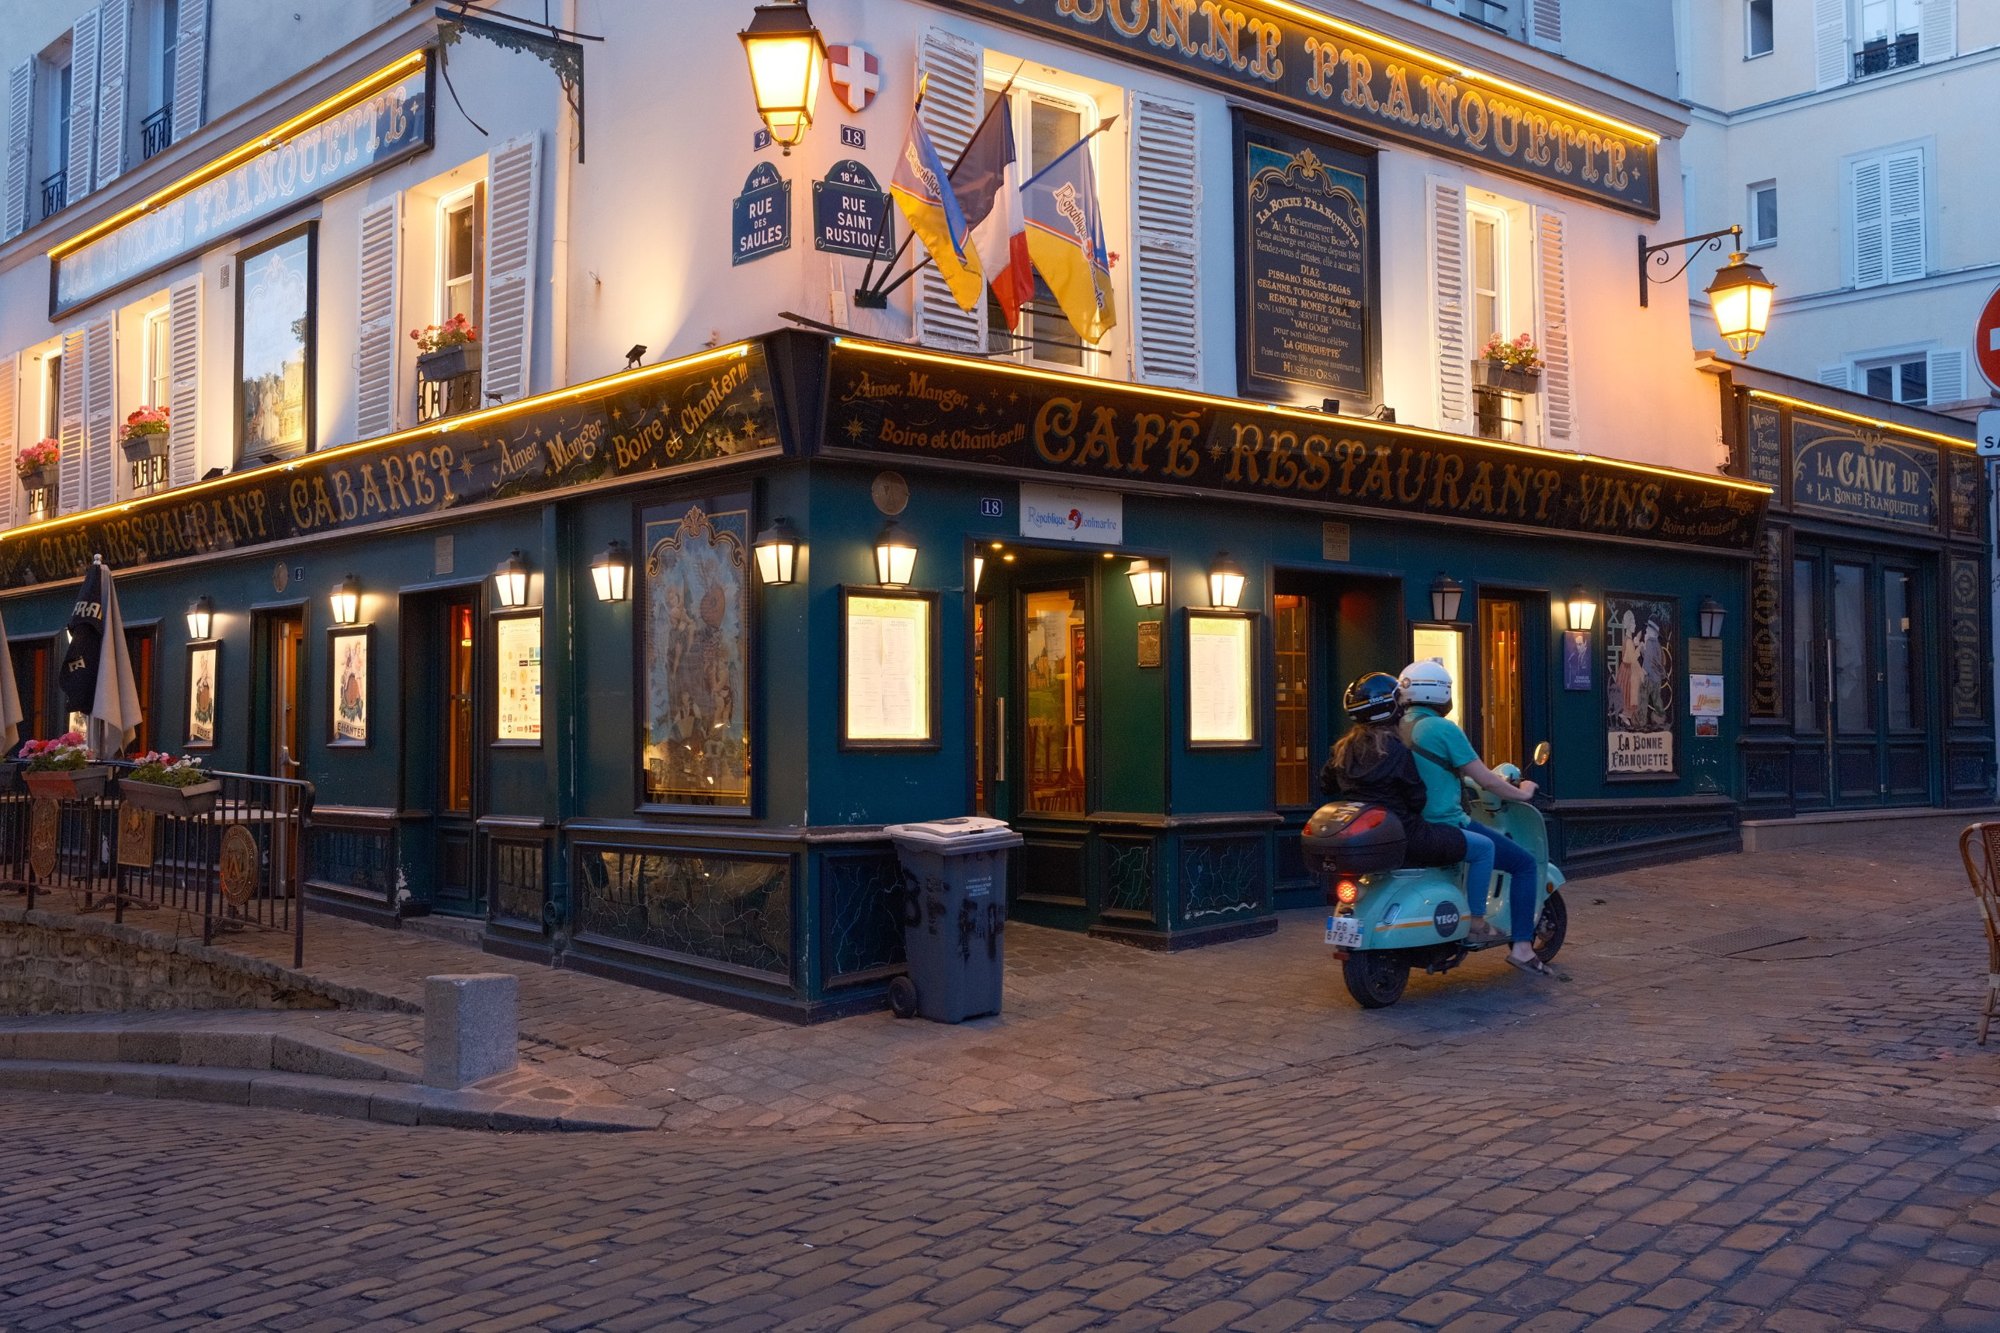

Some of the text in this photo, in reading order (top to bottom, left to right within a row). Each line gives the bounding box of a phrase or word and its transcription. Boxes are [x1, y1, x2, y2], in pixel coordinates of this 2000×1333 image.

[1305, 36, 1629, 191] FRANQUETTE
[759, 132, 766, 146] 2
[845, 130, 861, 146] 18
[102, 200, 186, 281] BONNE
[194, 86, 407, 238] FRANQUETTE
[749, 197, 773, 219] RUE
[842, 196, 866, 213] RUE
[754, 218, 767, 229] DES
[837, 212, 872, 231] SAINT
[1256, 197, 1360, 248] LA BONNE FRANQUETTE
[1285, 214, 1333, 234] Anciennement
[740, 225, 783, 252] SAULES
[825, 227, 885, 249] RUSTIQUE
[1256, 228, 1271, 239] Cette
[1272, 232, 1296, 248] auberge
[1297, 240, 1306, 248] est
[1327, 245, 1348, 259] depuis
[1289, 225, 1320, 240] BILLARDS
[1321, 235, 1330, 243] EN
[1256, 240, 1294, 259] Rendez-vous
[1322, 257, 1333, 267] elle
[1300, 264, 1320, 278] DIAZ
[1293, 286, 1361, 309] TOULOUSE-LAUTREC
[1328, 283, 1351, 296] DEGAS
[1257, 302, 1271, 312] SON
[1272, 304, 1294, 317] JARDIN
[1298, 311, 1319, 322] SERVIT
[1320, 315, 1328, 324] DE
[1273, 327, 1289, 336] pour
[1290, 330, 1302, 338] son
[1303, 332, 1326, 344] tableau
[1283, 361, 1308, 376] MUSÉE
[1752, 414, 1776, 430] Maison
[665, 428, 684, 459] et
[878, 417, 928, 447] Boire
[931, 432, 948, 449] et
[1984, 435, 2000, 449] S
[612, 418, 664, 470] Boire
[1033, 396, 1664, 530] CAFÉ RESTAURANT VINS
[1817, 451, 1919, 496] LA CAVE DE
[984, 501, 999, 515] 18
[1818, 483, 1919, 517] LA BONNE FRANQUETTE
[40, 525, 93, 578] CAFÉ
[103, 489, 266, 565] RESTAURANT
[289, 444, 455, 529] CABARET
[1618, 734, 1663, 752] LA BONNE
[1611, 752, 1669, 769] FRANQUETTE
[1436, 914, 1459, 925] YEGO
